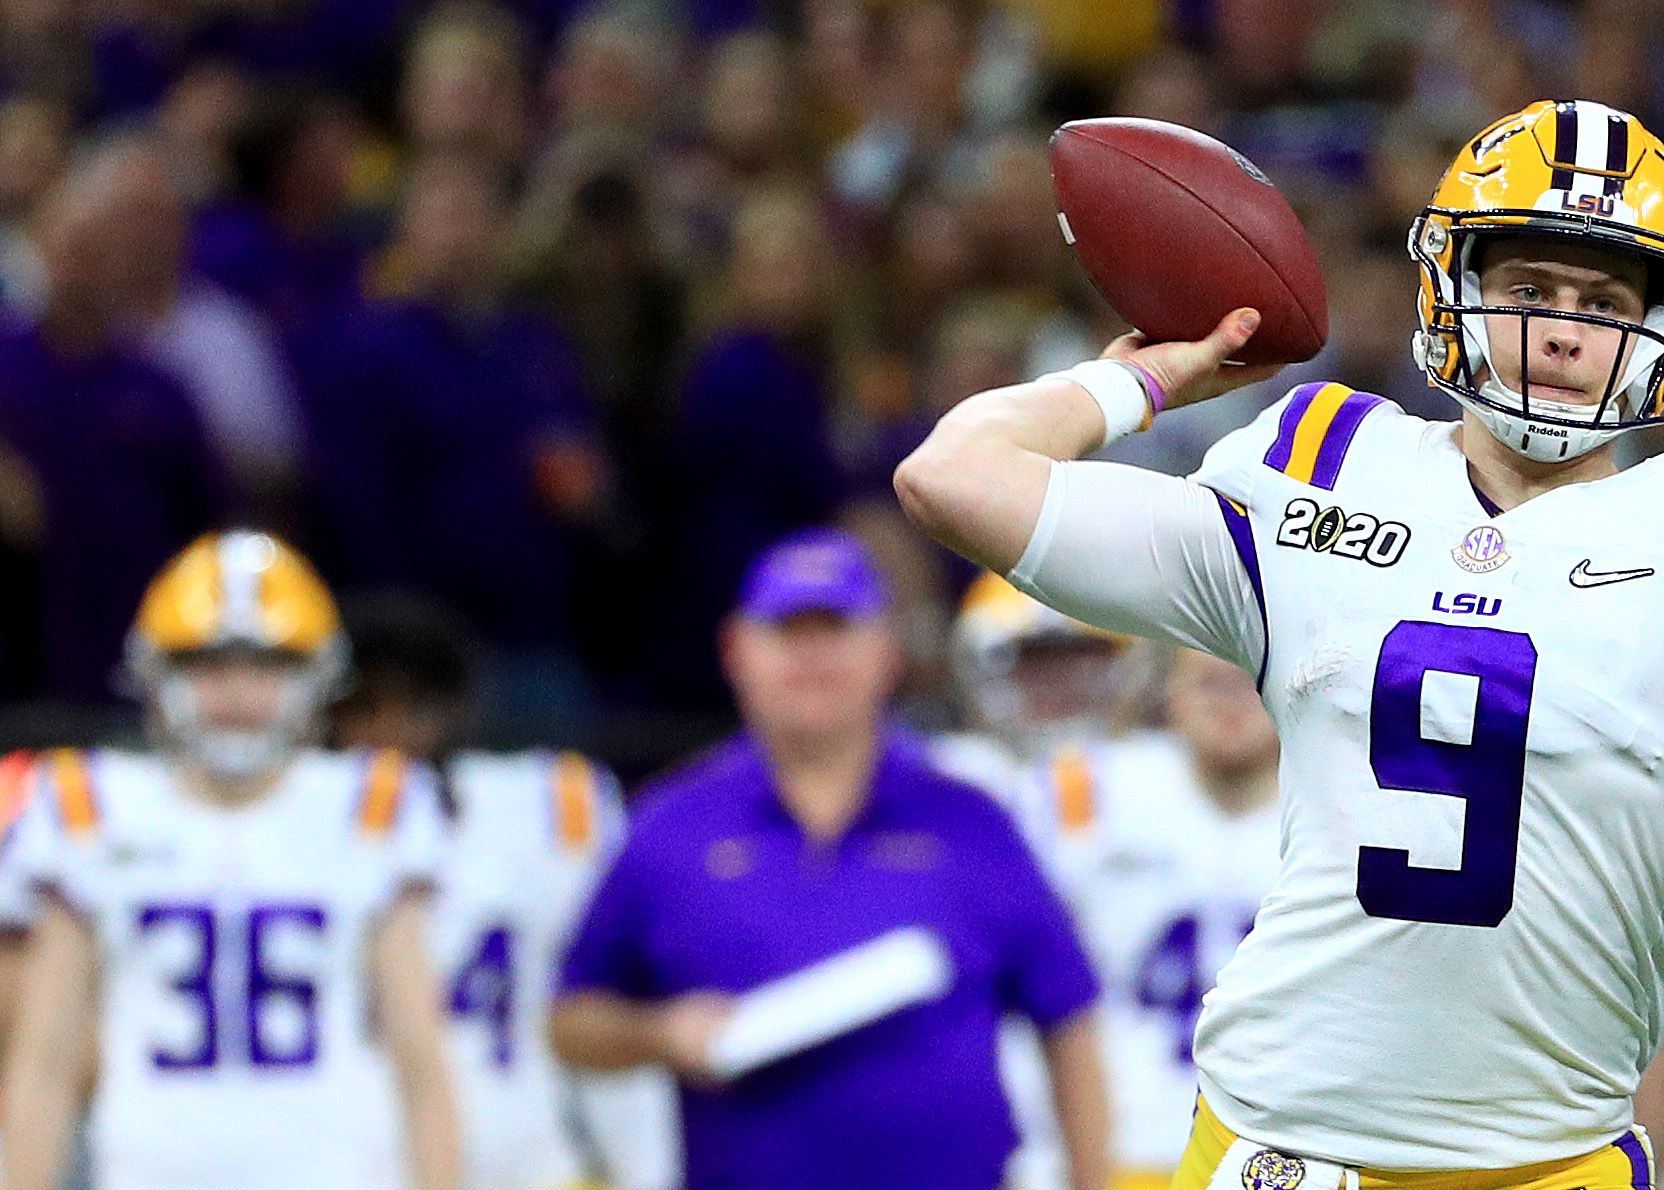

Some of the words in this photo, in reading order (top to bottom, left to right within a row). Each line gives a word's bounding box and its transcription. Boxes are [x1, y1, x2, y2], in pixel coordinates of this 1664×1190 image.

[1561, 191, 1614, 217] LSU
[1527, 424, 1568, 438] Riddell
[1465, 527, 1502, 561] SEC
[1432, 591, 1502, 617] LSU
[1356, 619, 1538, 928] 9
[137, 902, 323, 1068] 36
[1135, 912, 1254, 1066] 4
